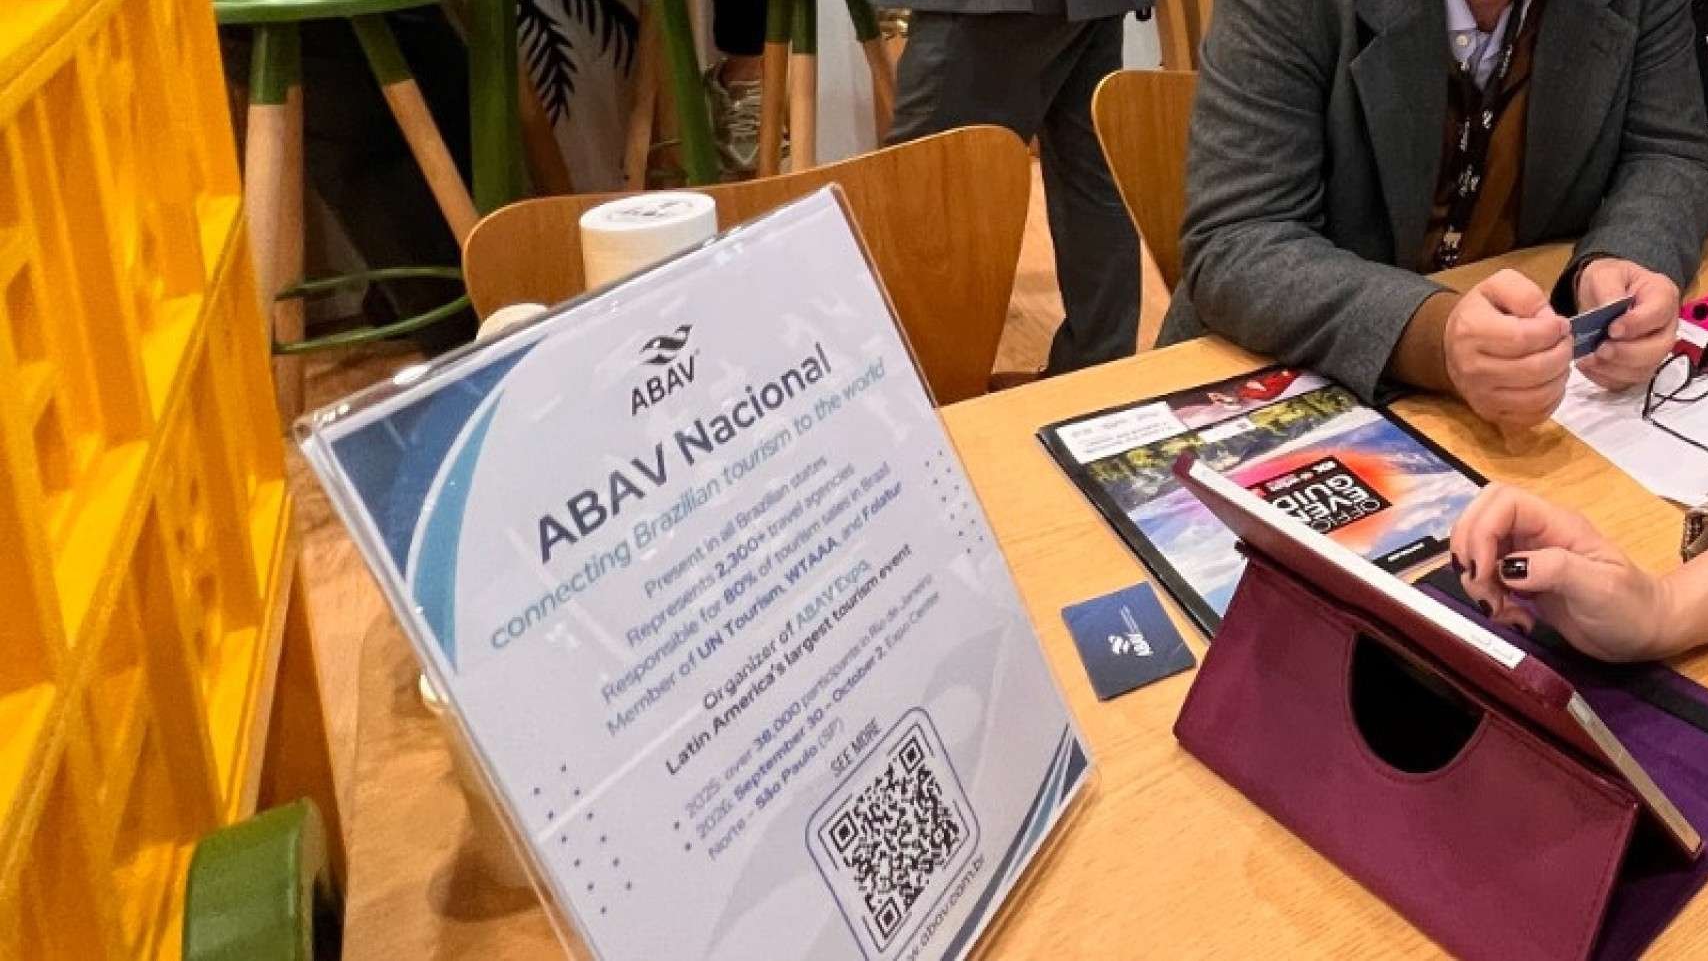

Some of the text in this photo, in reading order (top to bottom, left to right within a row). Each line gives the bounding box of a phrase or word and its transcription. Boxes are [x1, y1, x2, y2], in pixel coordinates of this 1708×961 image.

[533, 341, 832, 564] ABAV Nacional
[631, 355, 697, 417] ABAV
[491, 356, 887, 650] connecting Brazilian tourism to the world
[626, 574, 716, 648] Represents
[768, 500, 804, 538] travel
[804, 462, 856, 510] agencies
[643, 455, 828, 599] Present in all Brazilian states
[1272, 474, 1354, 514] GUID
[1310, 497, 1381, 532] OFFIC
[601, 620, 700, 704] Responsible
[699, 599, 722, 622] for
[722, 571, 759, 606] 80%
[758, 553, 773, 578] of
[773, 520, 822, 564] tourism
[821, 496, 851, 526] sales
[859, 460, 892, 492] Brazil
[605, 670, 676, 738] Member
[678, 649, 697, 676] of
[696, 629, 725, 660] UN
[841, 513, 864, 541] and
[702, 640, 776, 710] Organizer
[778, 618, 795, 645] of
[795, 583, 835, 629] ABAV
[665, 730, 712, 777] Latin
[783, 617, 834, 667] largest
[831, 574, 880, 622] tourism
[878, 543, 913, 580] event
[733, 725, 806, 802] September
[806, 707, 825, 730] 30
[831, 655, 879, 703] October
[707, 817, 747, 862] Norte
[755, 780, 782, 811] São
[780, 744, 820, 785] Paulo
[830, 717, 881, 779] SEE MORE
